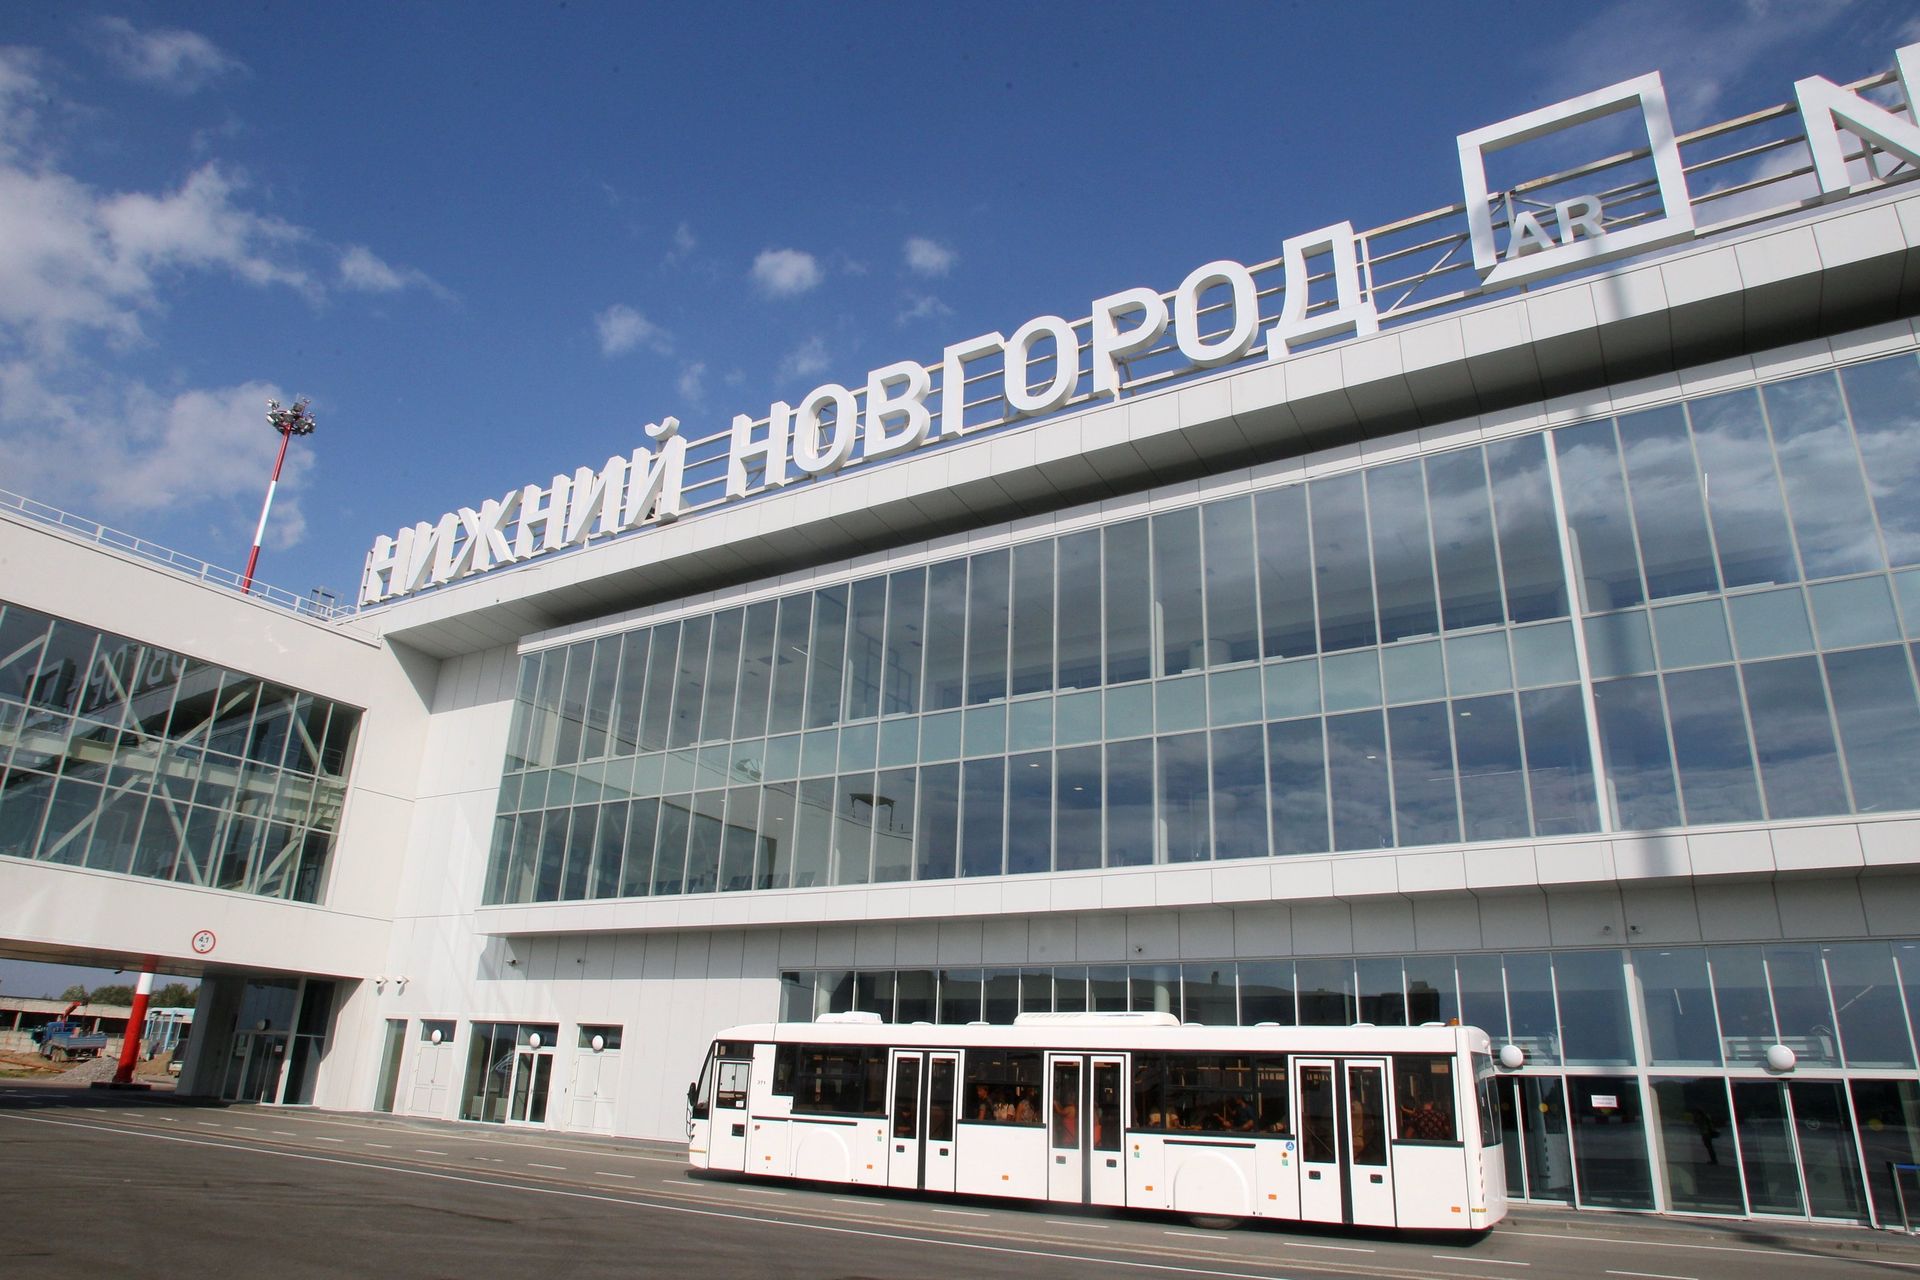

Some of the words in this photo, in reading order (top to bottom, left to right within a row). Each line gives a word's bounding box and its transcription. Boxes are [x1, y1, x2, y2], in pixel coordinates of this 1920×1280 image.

[1505, 195, 1606, 260] AR
[361, 416, 687, 605] НИЖНИЙ
[726, 220, 1378, 500] НОВГОРОД
